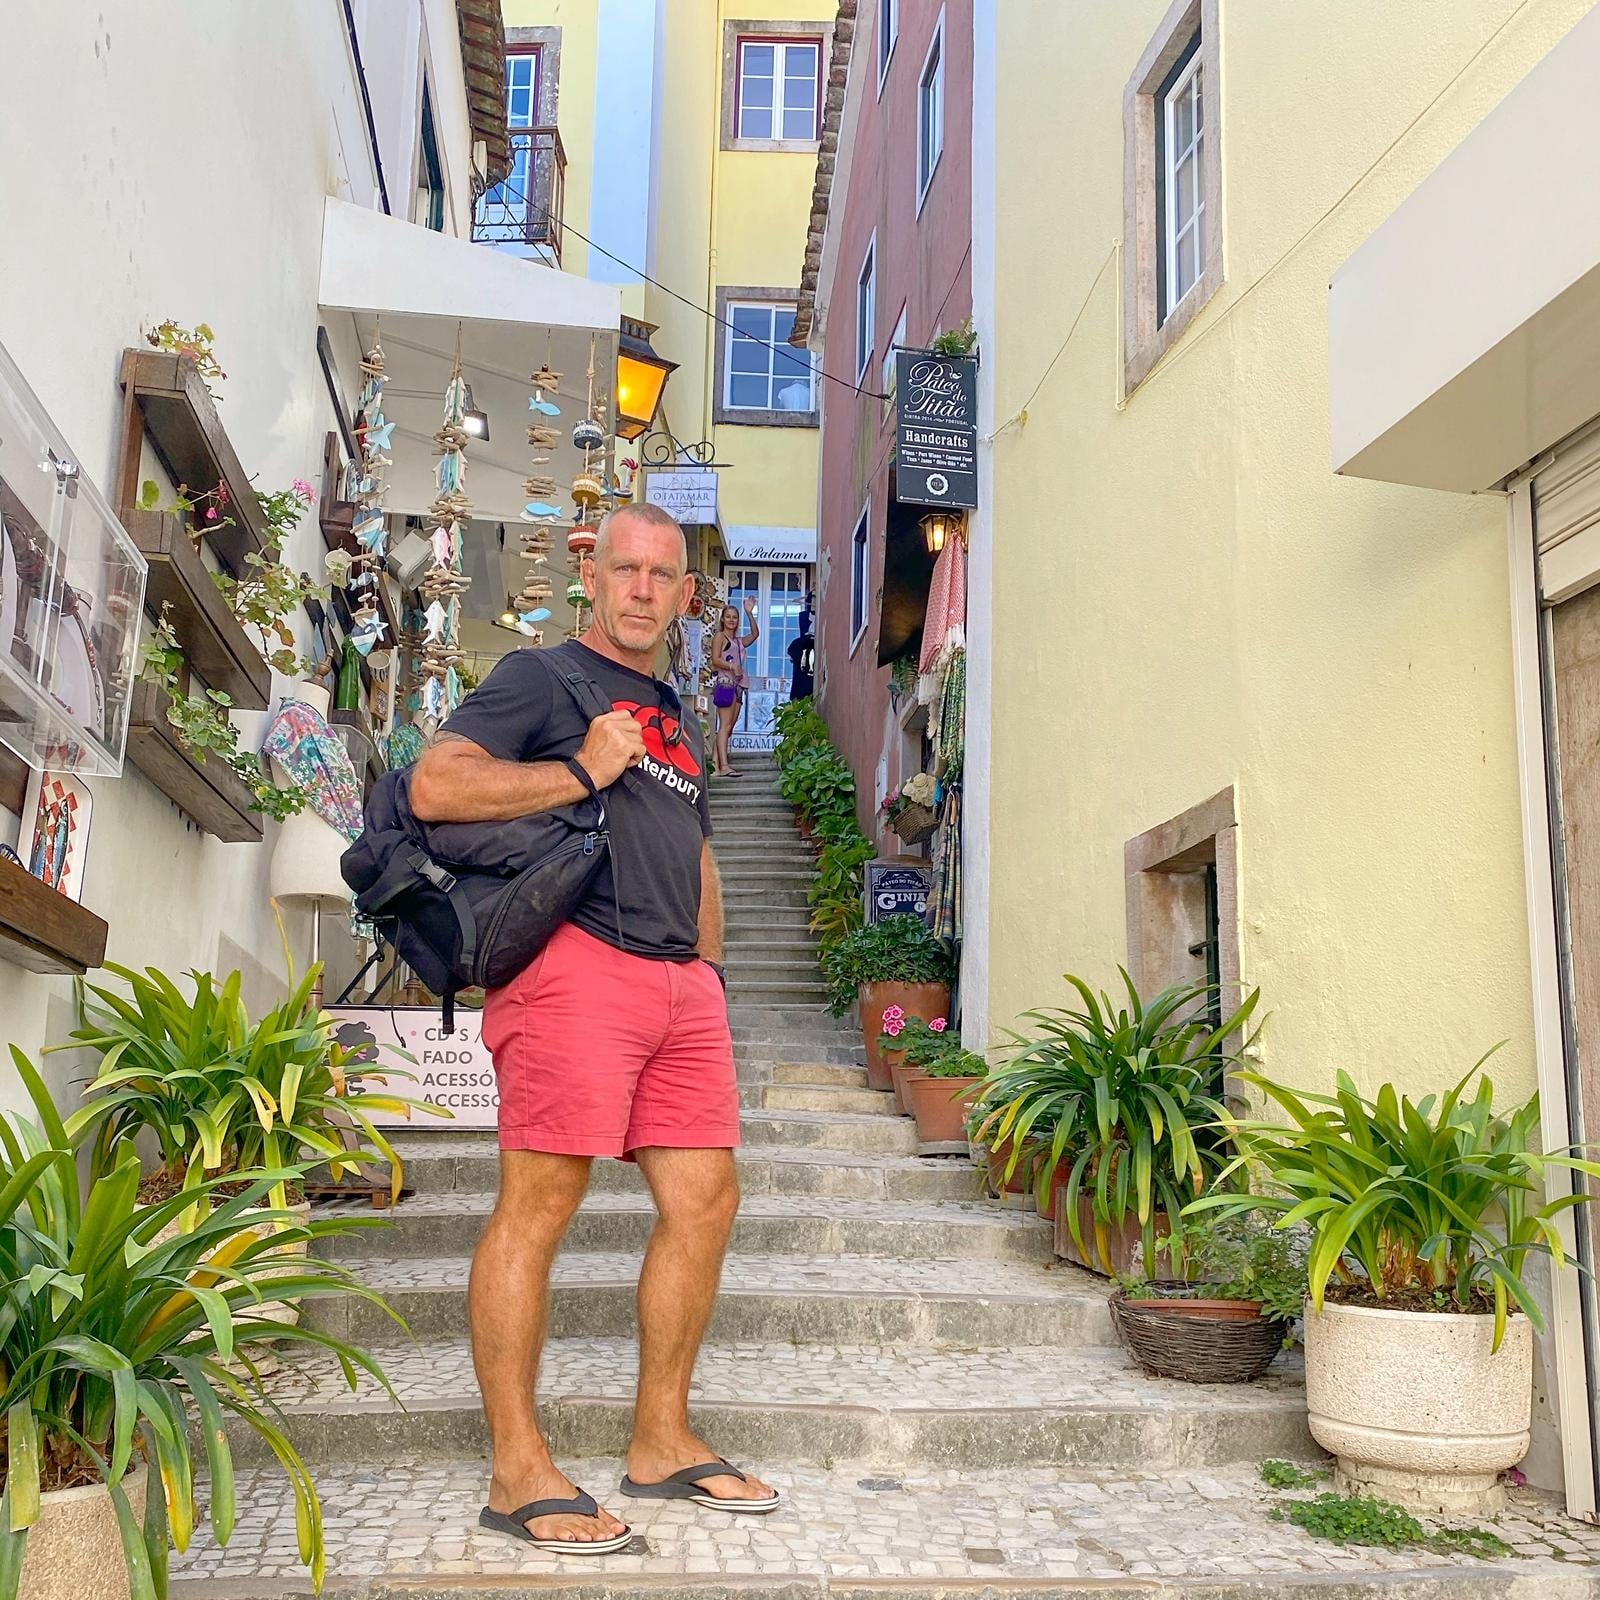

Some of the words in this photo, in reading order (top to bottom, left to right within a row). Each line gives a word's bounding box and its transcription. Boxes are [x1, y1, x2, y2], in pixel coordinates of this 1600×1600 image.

[904, 386, 968, 418] Titão
[952, 389, 967, 402] do
[905, 430, 968, 448] Handcrafts
[734, 546, 744, 558] O
[877, 893, 926, 910] GINJA
[423, 1050, 473, 1065] FADO
